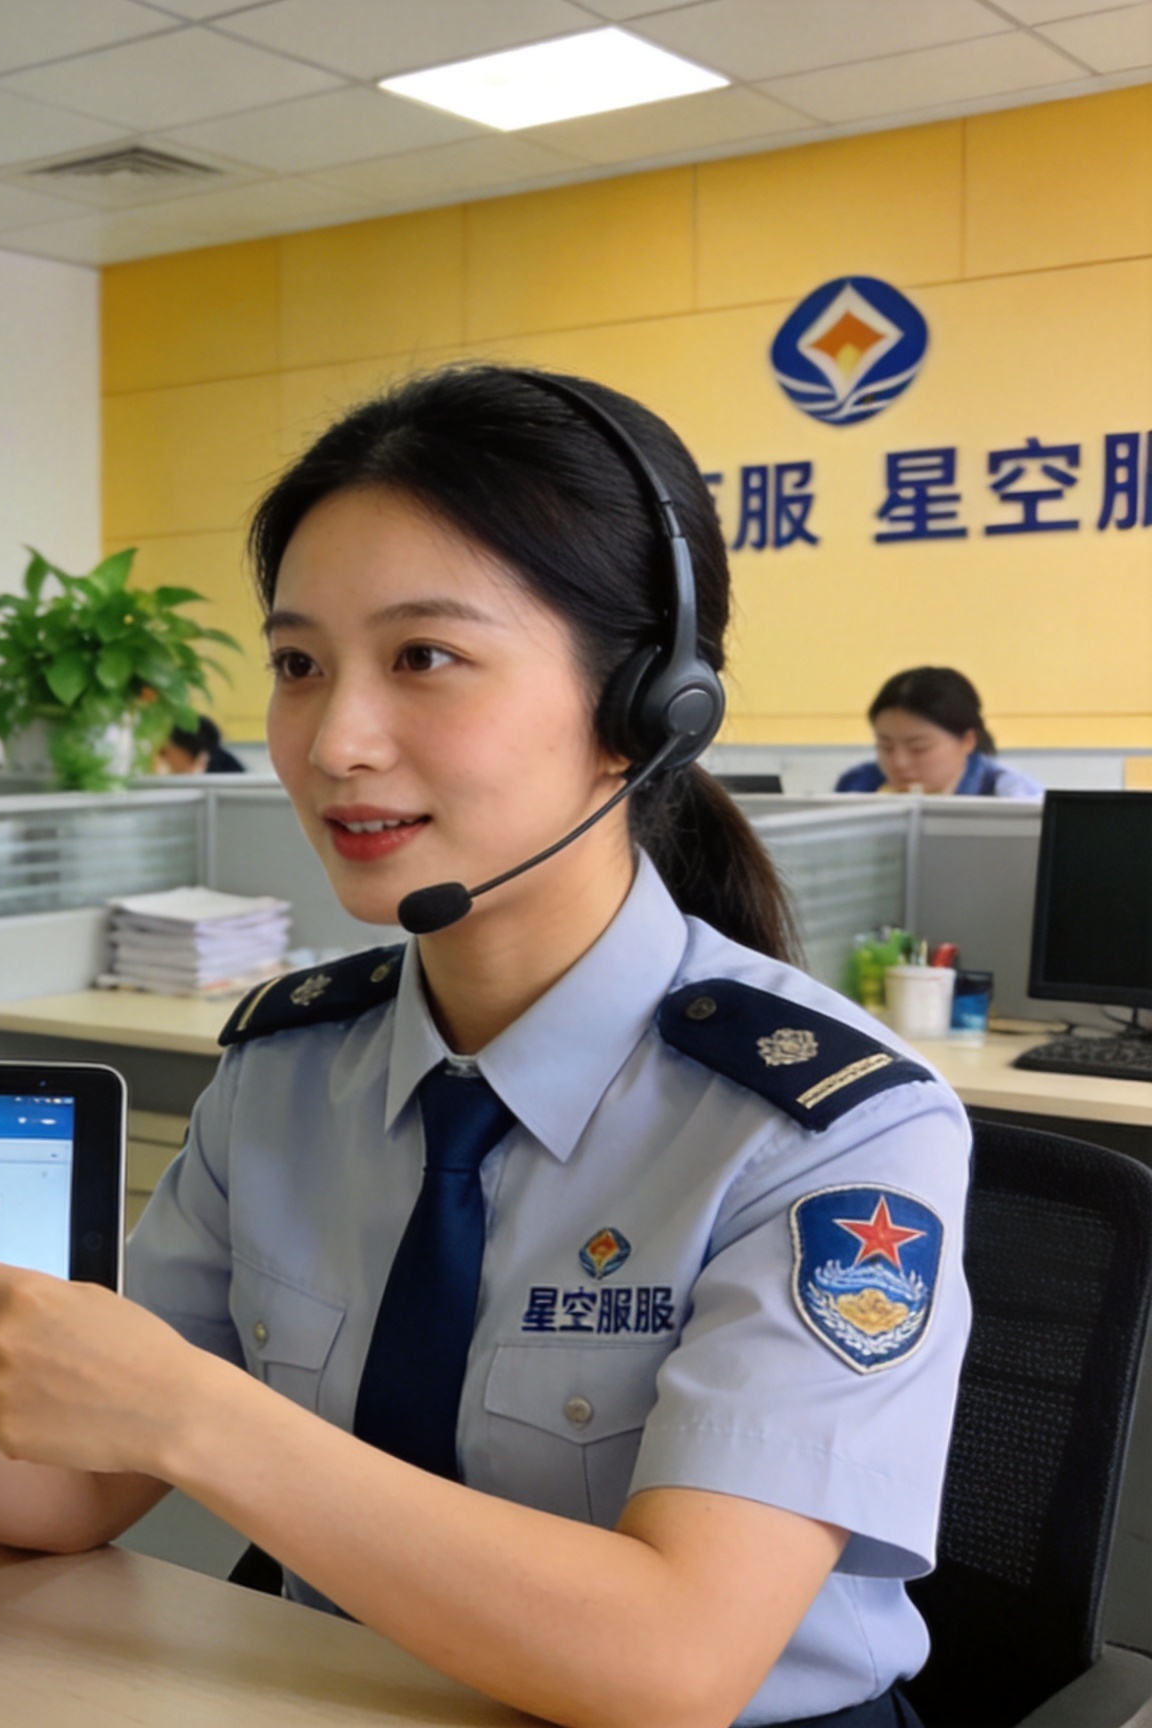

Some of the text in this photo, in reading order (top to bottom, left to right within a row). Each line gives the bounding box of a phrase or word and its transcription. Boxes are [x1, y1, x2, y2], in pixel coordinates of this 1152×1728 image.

[701, 461, 820, 551] 服
[521, 1286, 676, 1334] 星空服服
